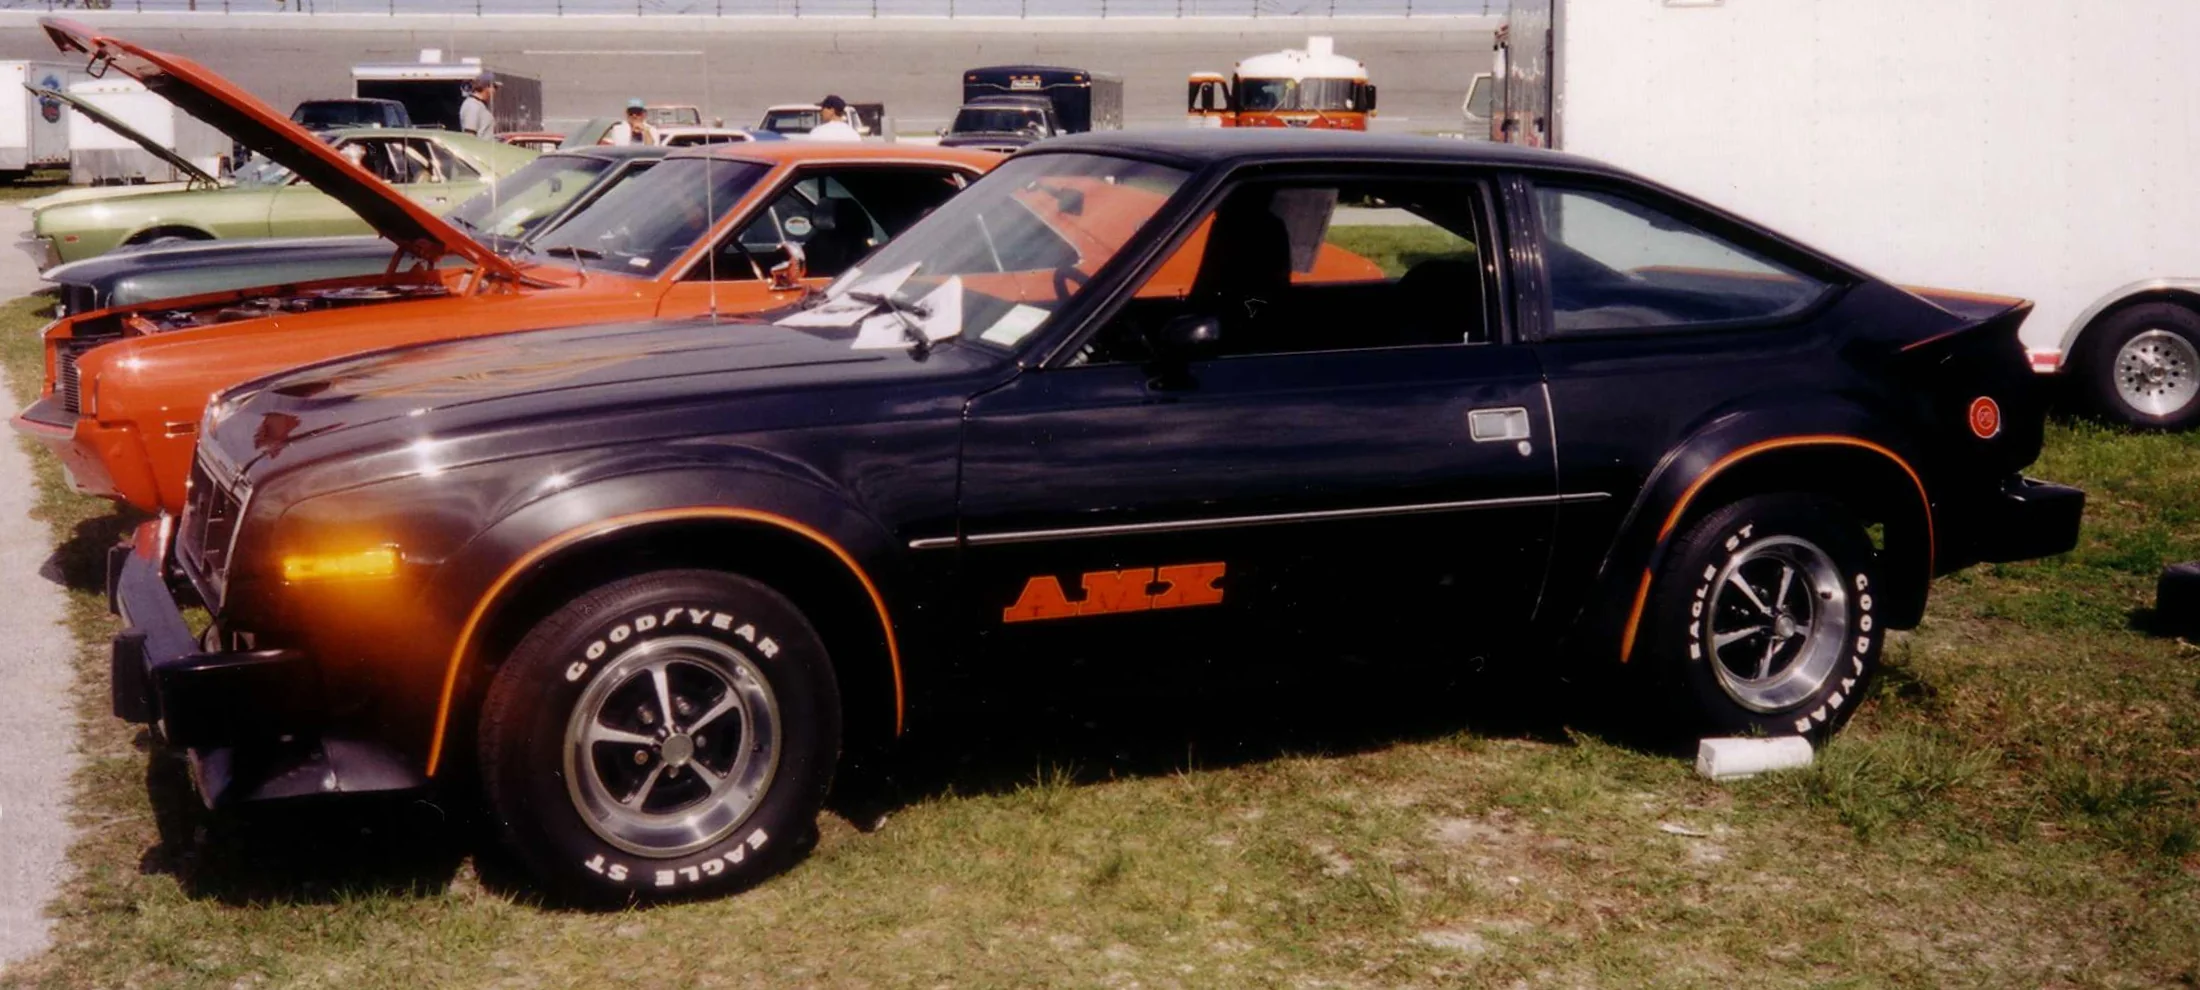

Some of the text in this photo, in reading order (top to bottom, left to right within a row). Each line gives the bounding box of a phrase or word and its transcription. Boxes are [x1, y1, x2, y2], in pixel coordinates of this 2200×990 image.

[1003, 561, 1225, 622] AMX
[1690, 523, 1753, 659] EAGLE ST
[565, 607, 780, 683] GOODYEAR
[1795, 573, 1872, 733] GOODYEAR
[584, 827, 769, 887] EAGLE ST
